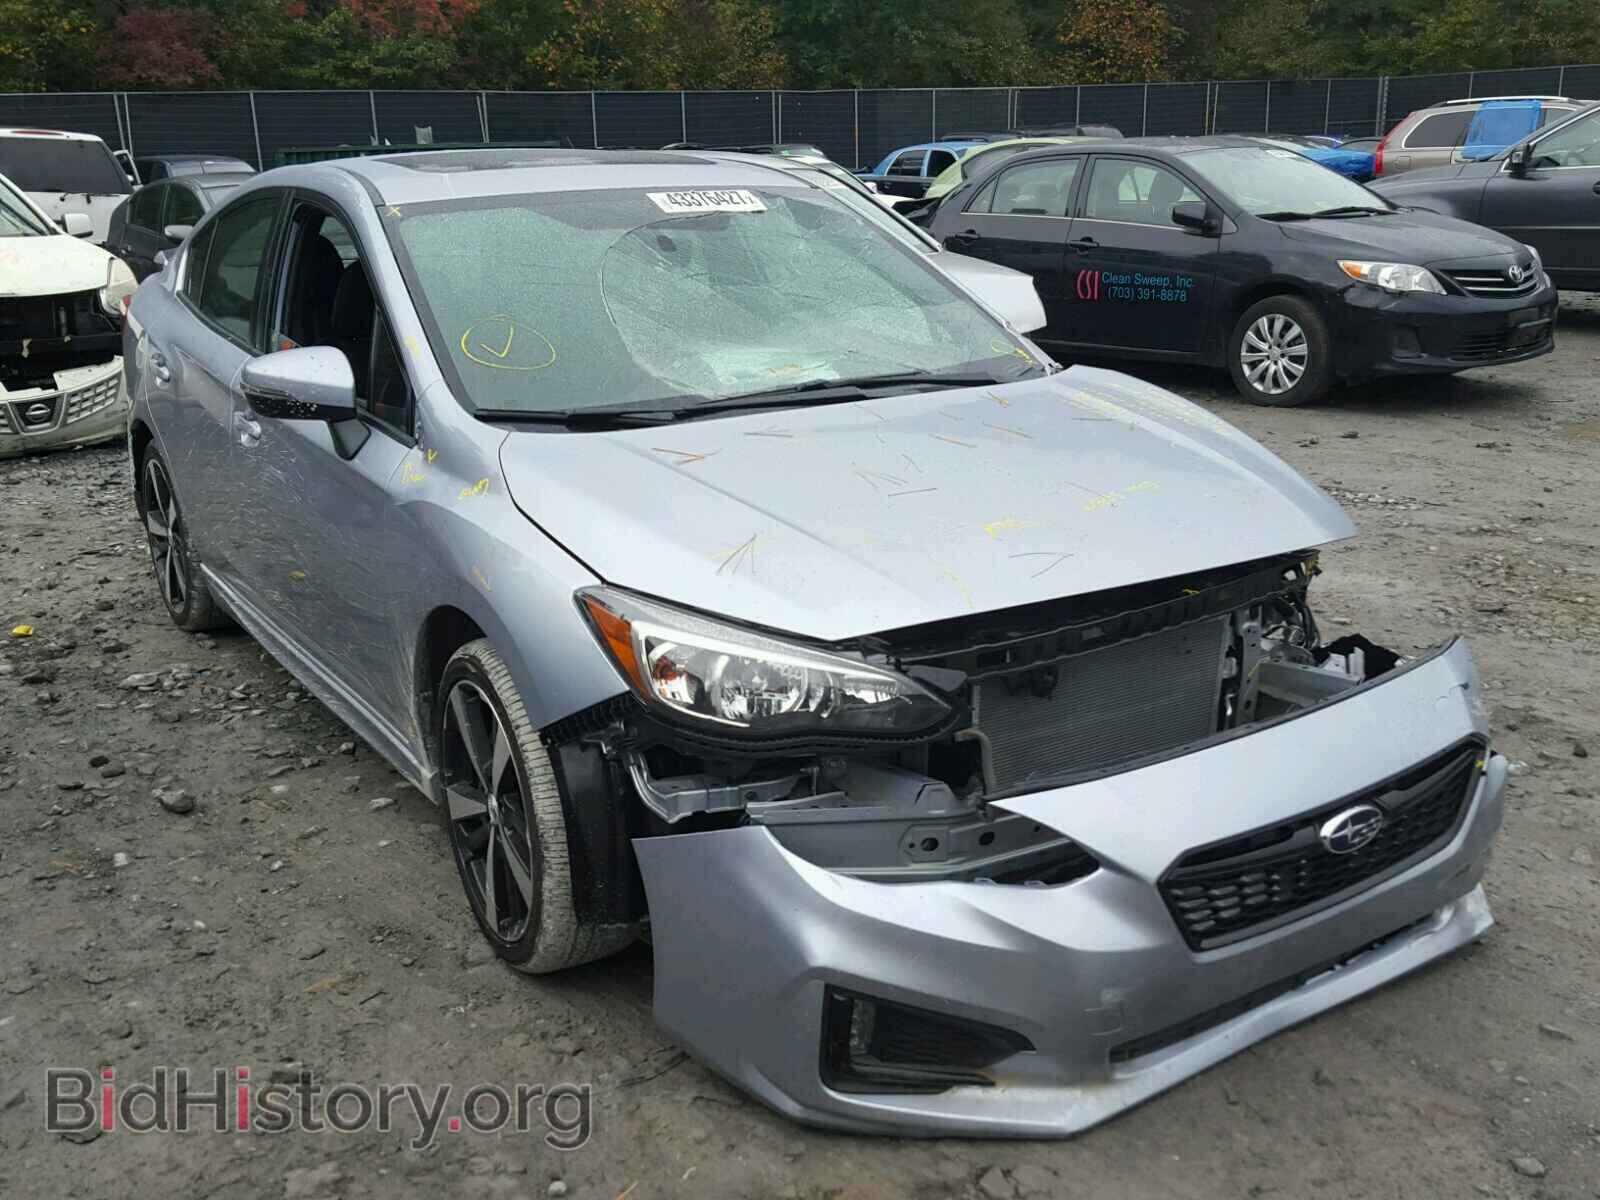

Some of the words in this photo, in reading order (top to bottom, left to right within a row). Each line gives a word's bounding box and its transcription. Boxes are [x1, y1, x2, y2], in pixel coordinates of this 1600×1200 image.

[1101, 272, 1131, 283] Clean
[1077, 270, 1099, 300] CSI
[1108, 286, 1135, 300] (703)
